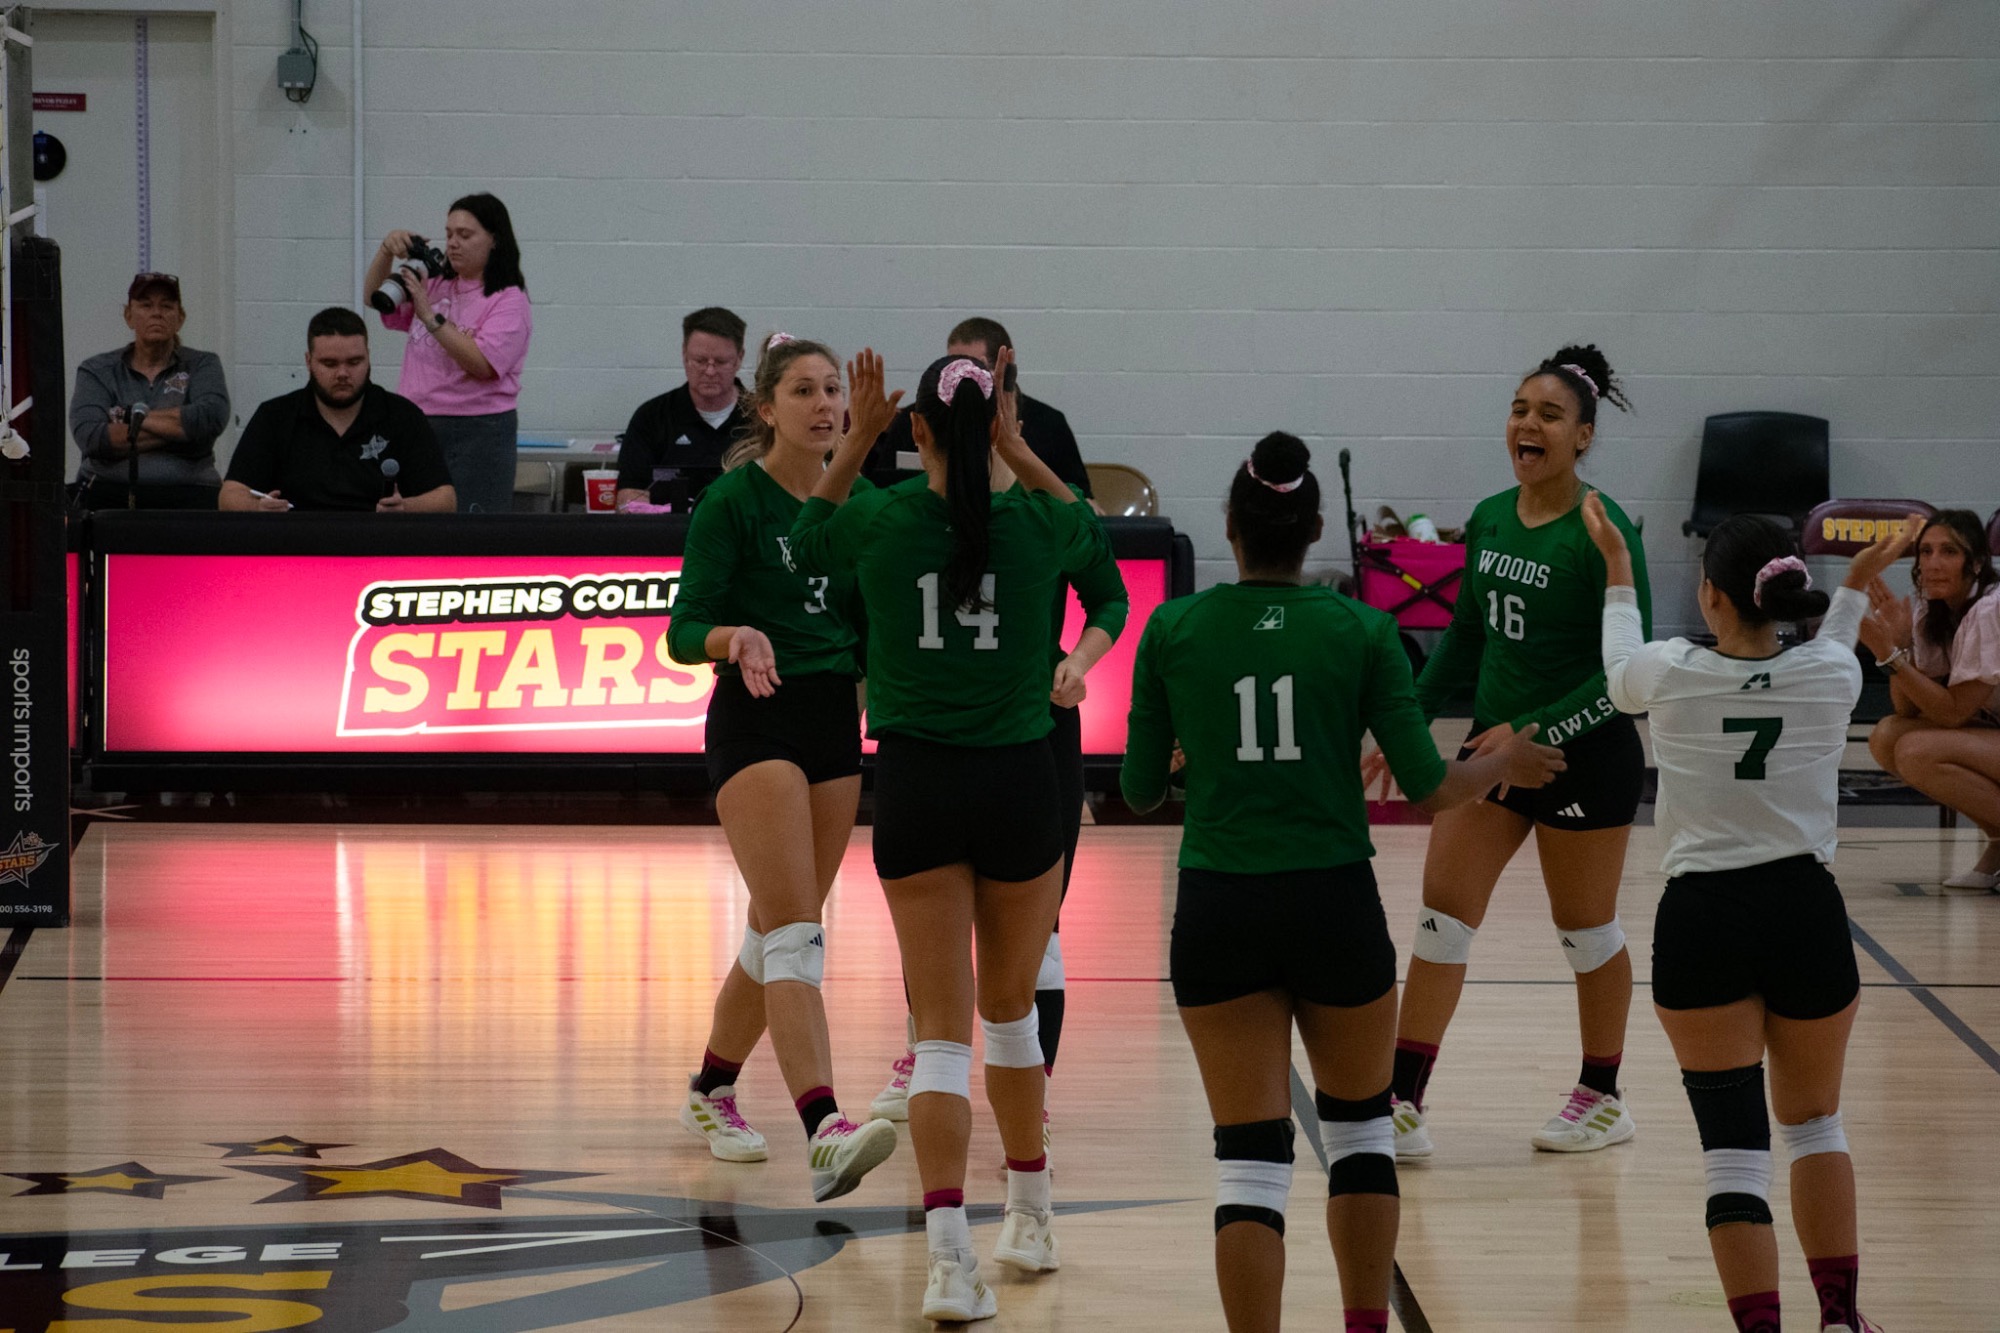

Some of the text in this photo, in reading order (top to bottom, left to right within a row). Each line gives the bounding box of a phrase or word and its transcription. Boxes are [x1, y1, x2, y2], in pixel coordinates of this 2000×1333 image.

[1478, 549, 1551, 589] WOODS
[369, 586, 564, 619] STEPHENS
[803, 576, 829, 614] 3
[917, 572, 1000, 650] 14
[1487, 590, 1526, 641] 16
[363, 626, 714, 714] STARS
[9, 648, 34, 812] sports imports
[1233, 674, 1302, 762] 11
[1547, 696, 1615, 746] OWLS
[1722, 717, 1783, 780] 7
[14, 904, 53, 914] 556-3198
